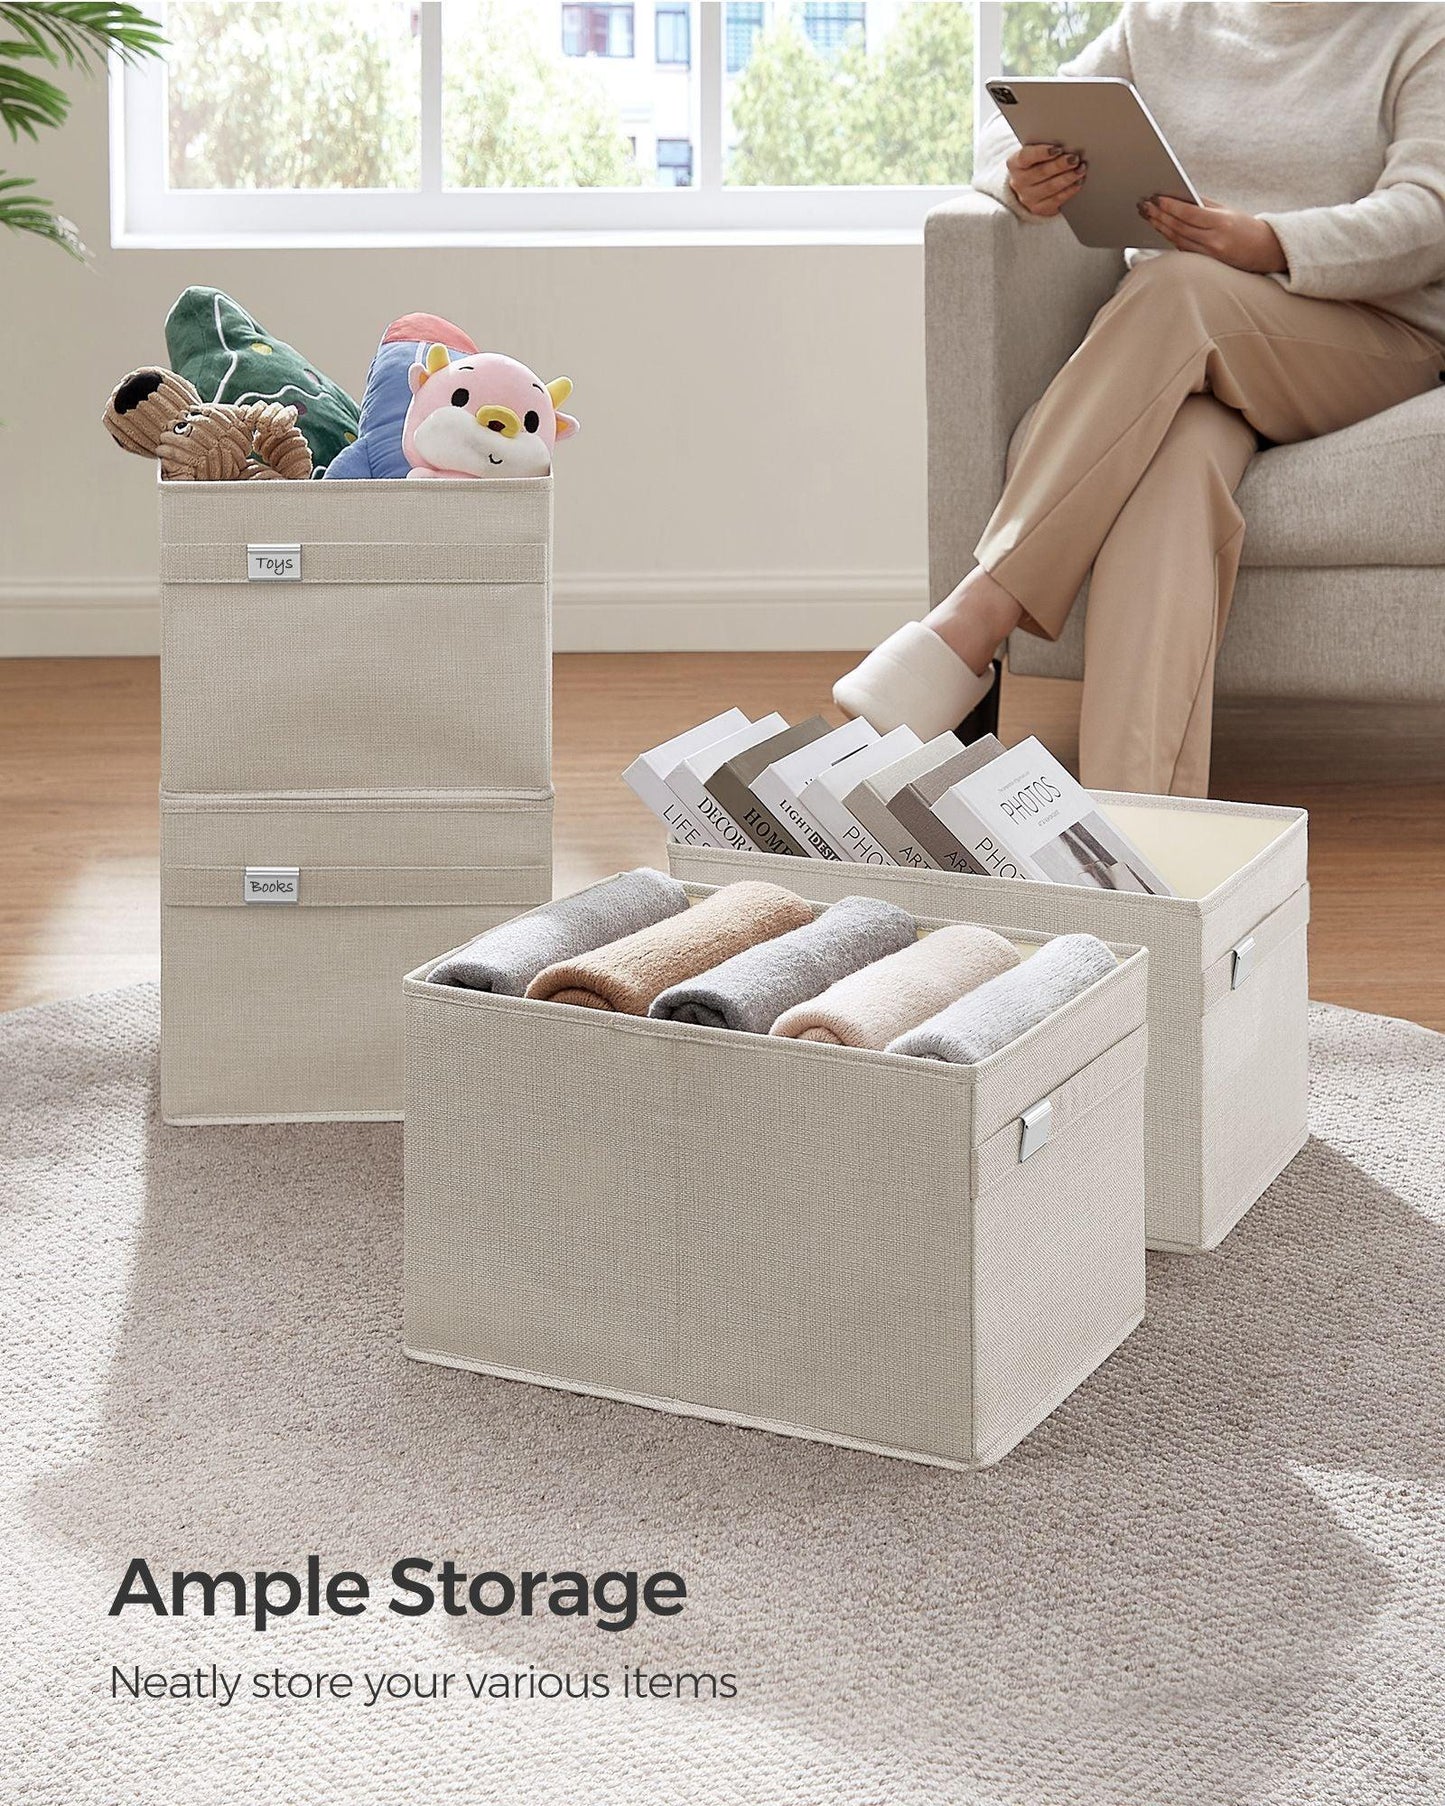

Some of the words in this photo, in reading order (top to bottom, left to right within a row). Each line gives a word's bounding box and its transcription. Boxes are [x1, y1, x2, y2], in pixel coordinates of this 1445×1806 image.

[255, 557, 293, 575] Toys
[1000, 776, 1061, 825] PHOTOS
[663, 804, 701, 845] LIFE
[842, 826, 891, 866] PHO
[974, 837, 1026, 879] PHO
[250, 879, 294, 893] Books
